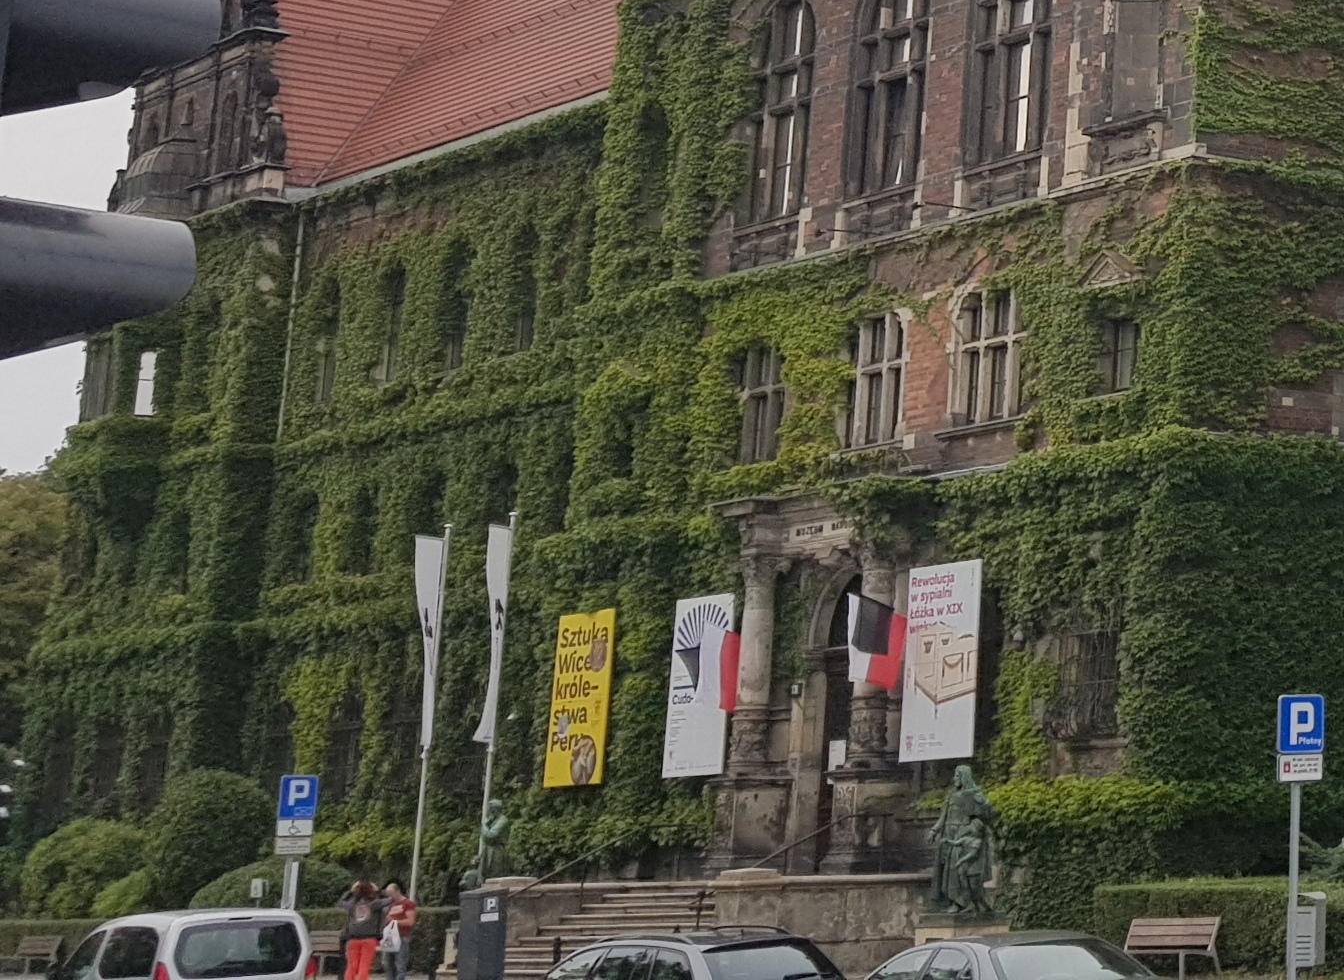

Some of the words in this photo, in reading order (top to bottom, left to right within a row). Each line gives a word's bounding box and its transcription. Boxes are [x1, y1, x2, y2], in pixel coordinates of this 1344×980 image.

[912, 572, 955, 587] Rewolucja
[921, 586, 953, 604] sypialni
[946, 602, 963, 614] XIX
[560, 622, 609, 648] Sztuka
[555, 675, 599, 700] króle-
[1290, 702, 1315, 745] P
[287, 779, 311, 807] P
[487, 898, 496, 911] P
